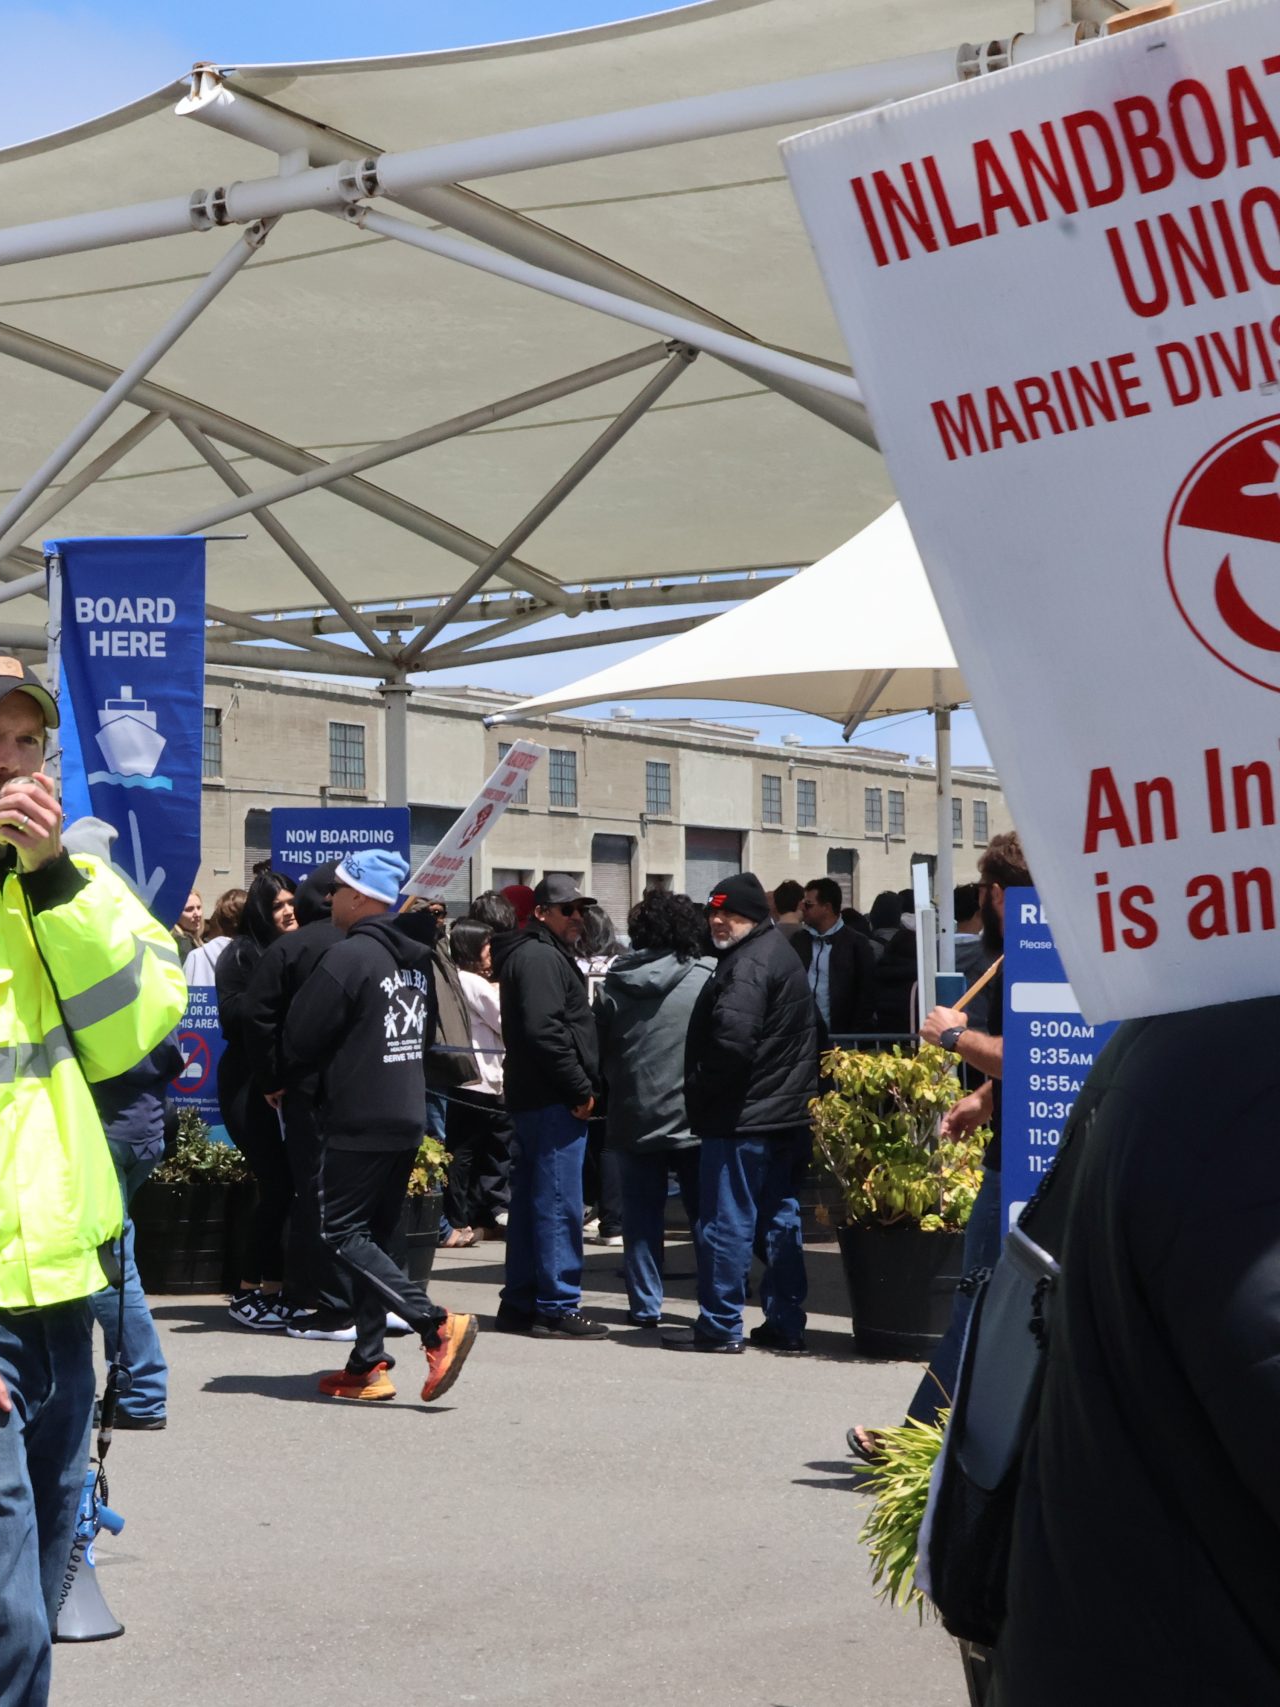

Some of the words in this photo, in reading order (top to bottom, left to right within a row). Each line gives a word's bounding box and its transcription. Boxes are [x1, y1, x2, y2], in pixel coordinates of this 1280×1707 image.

[931, 352, 1151, 461] MARINE
[76, 597, 176, 624] BOARD
[89, 631, 167, 658] HERE
[1084, 766, 1178, 854] An
[1204, 738, 1280, 833] In
[286, 830, 317, 843] NOW
[320, 830, 394, 844] BOARDING
[280, 850, 312, 863] THIS
[315, 850, 360, 863] DEPA
[1095, 872, 1159, 953] is
[1185, 866, 1275, 941] an
[1020, 939, 1052, 949] Please
[188, 993, 208, 1003] TICE
[190, 1006, 203, 1016] OR
[205, 1006, 219, 1016] DR
[179, 1019, 193, 1029] HIS
[195, 1019, 219, 1029] AREA
[1030, 1020, 1094, 1038] 9:00AM
[383, 1053, 406, 1063] SERVE
[1030, 1047, 1093, 1065] 9:35AM
[1029, 1074, 1085, 1092] 9:55A
[1028, 1129, 1060, 1146] 11:0
